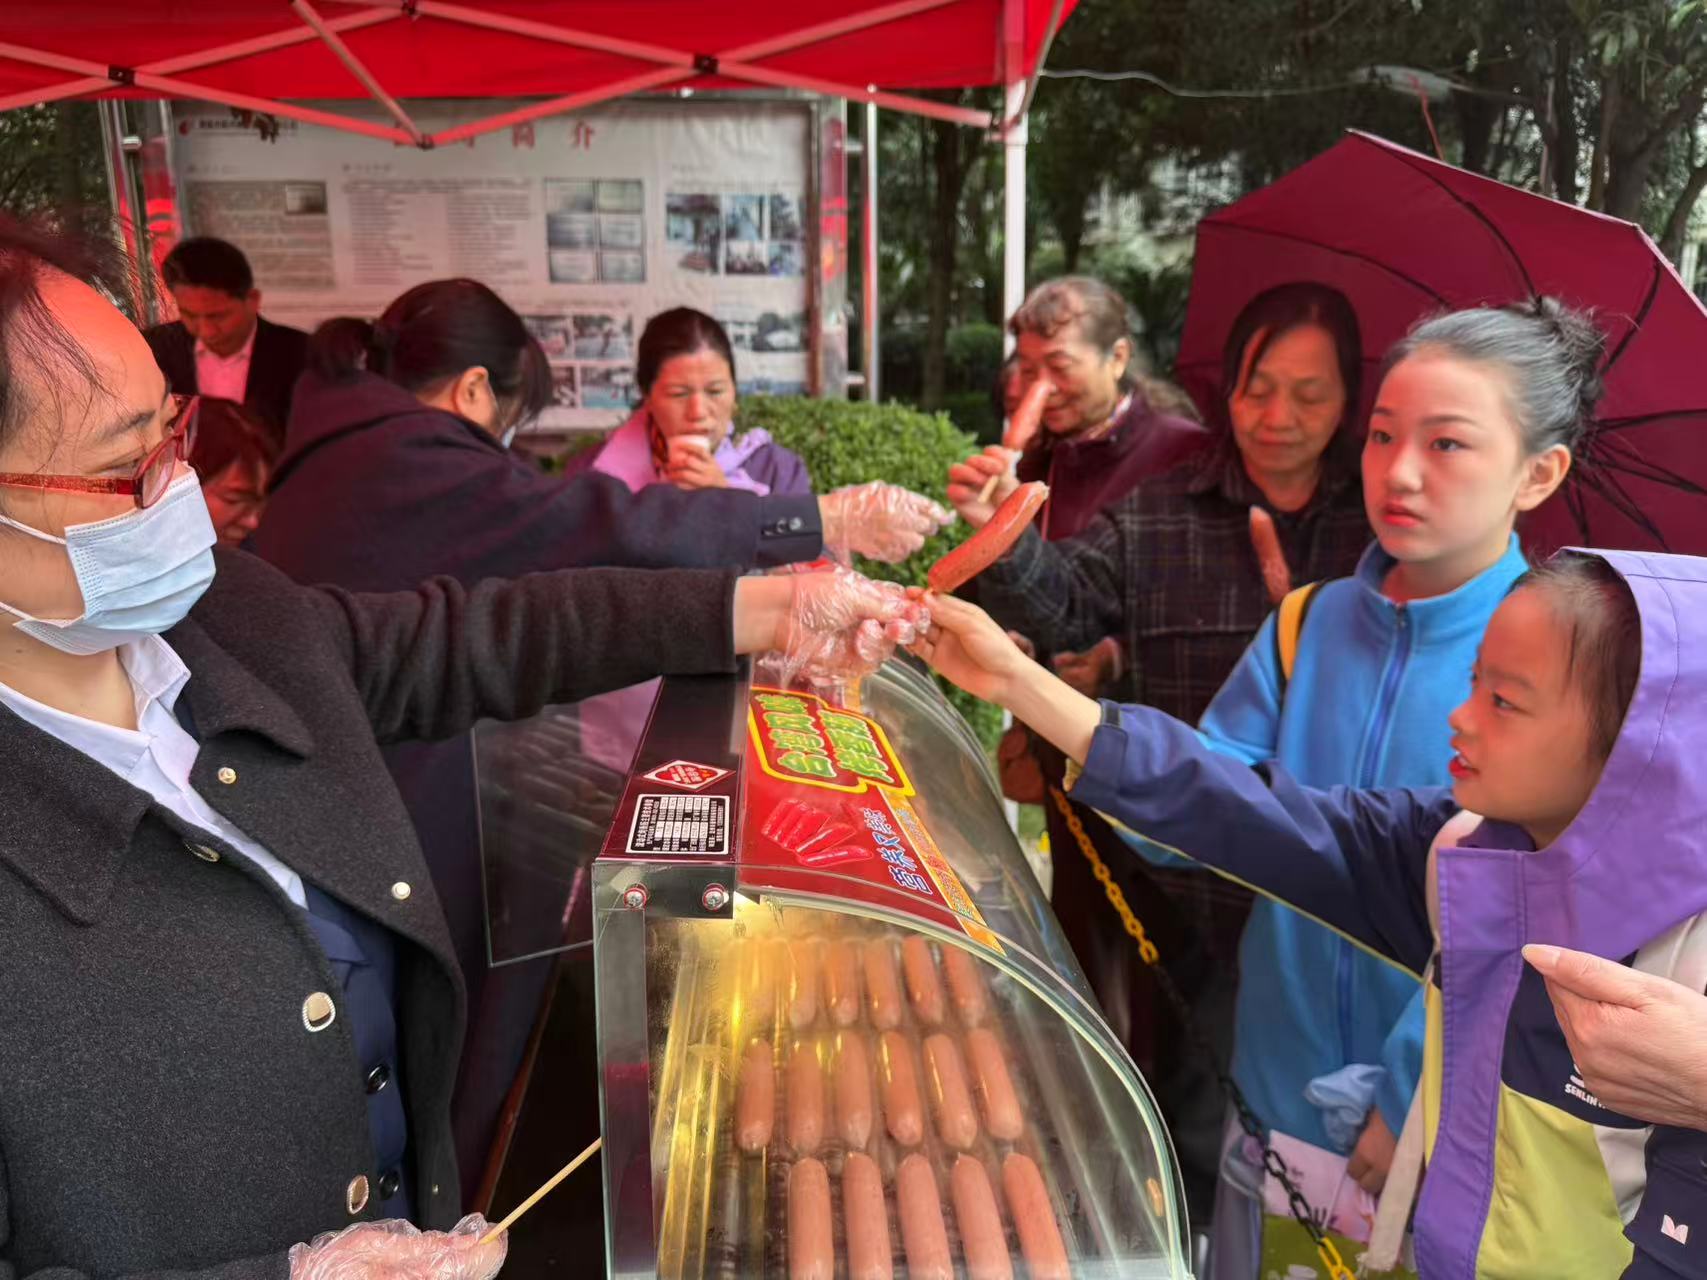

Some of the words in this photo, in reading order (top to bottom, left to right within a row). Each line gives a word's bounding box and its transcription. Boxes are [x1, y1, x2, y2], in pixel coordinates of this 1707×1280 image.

[755, 694, 837, 778] 台湾风味
[863, 807, 933, 895] 营养又美味
